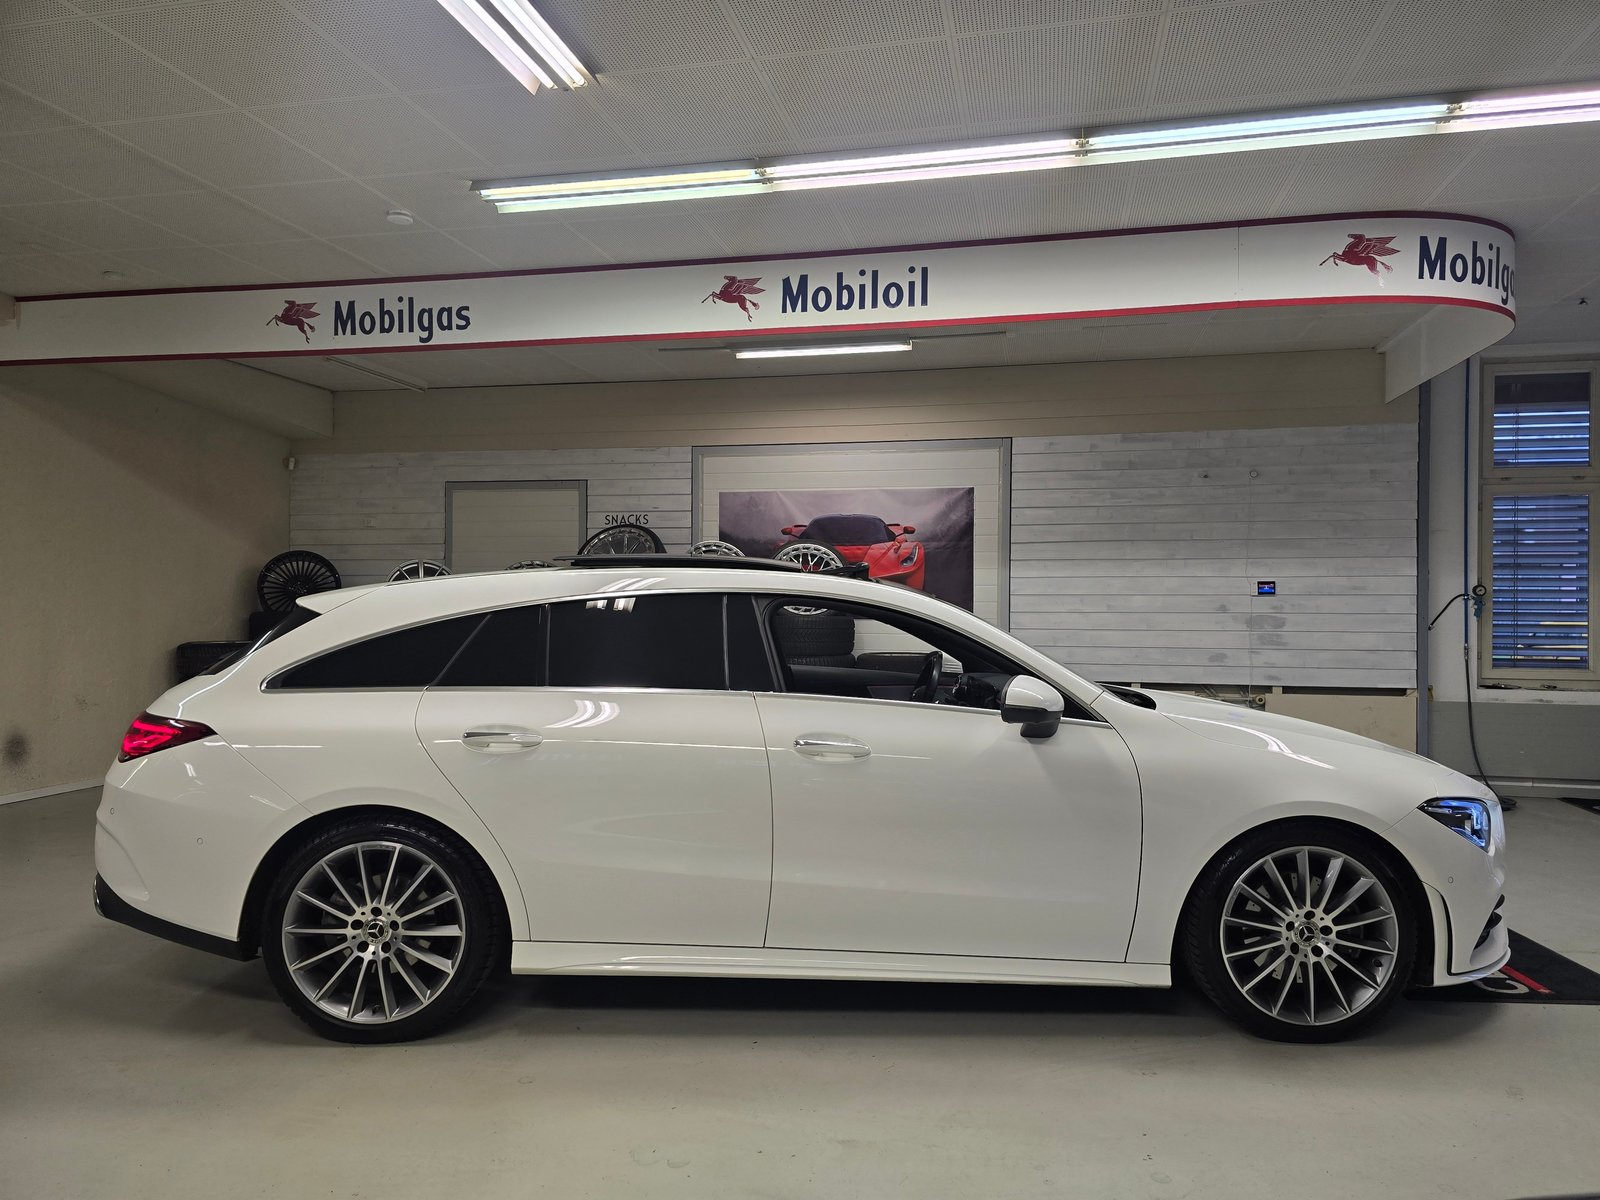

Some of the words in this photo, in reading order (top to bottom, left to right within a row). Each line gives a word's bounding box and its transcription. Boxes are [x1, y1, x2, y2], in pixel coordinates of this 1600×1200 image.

[781, 265, 928, 314] Mobiloil
[333, 296, 471, 343] Mobilgas
[604, 514, 649, 525] SNACKS
